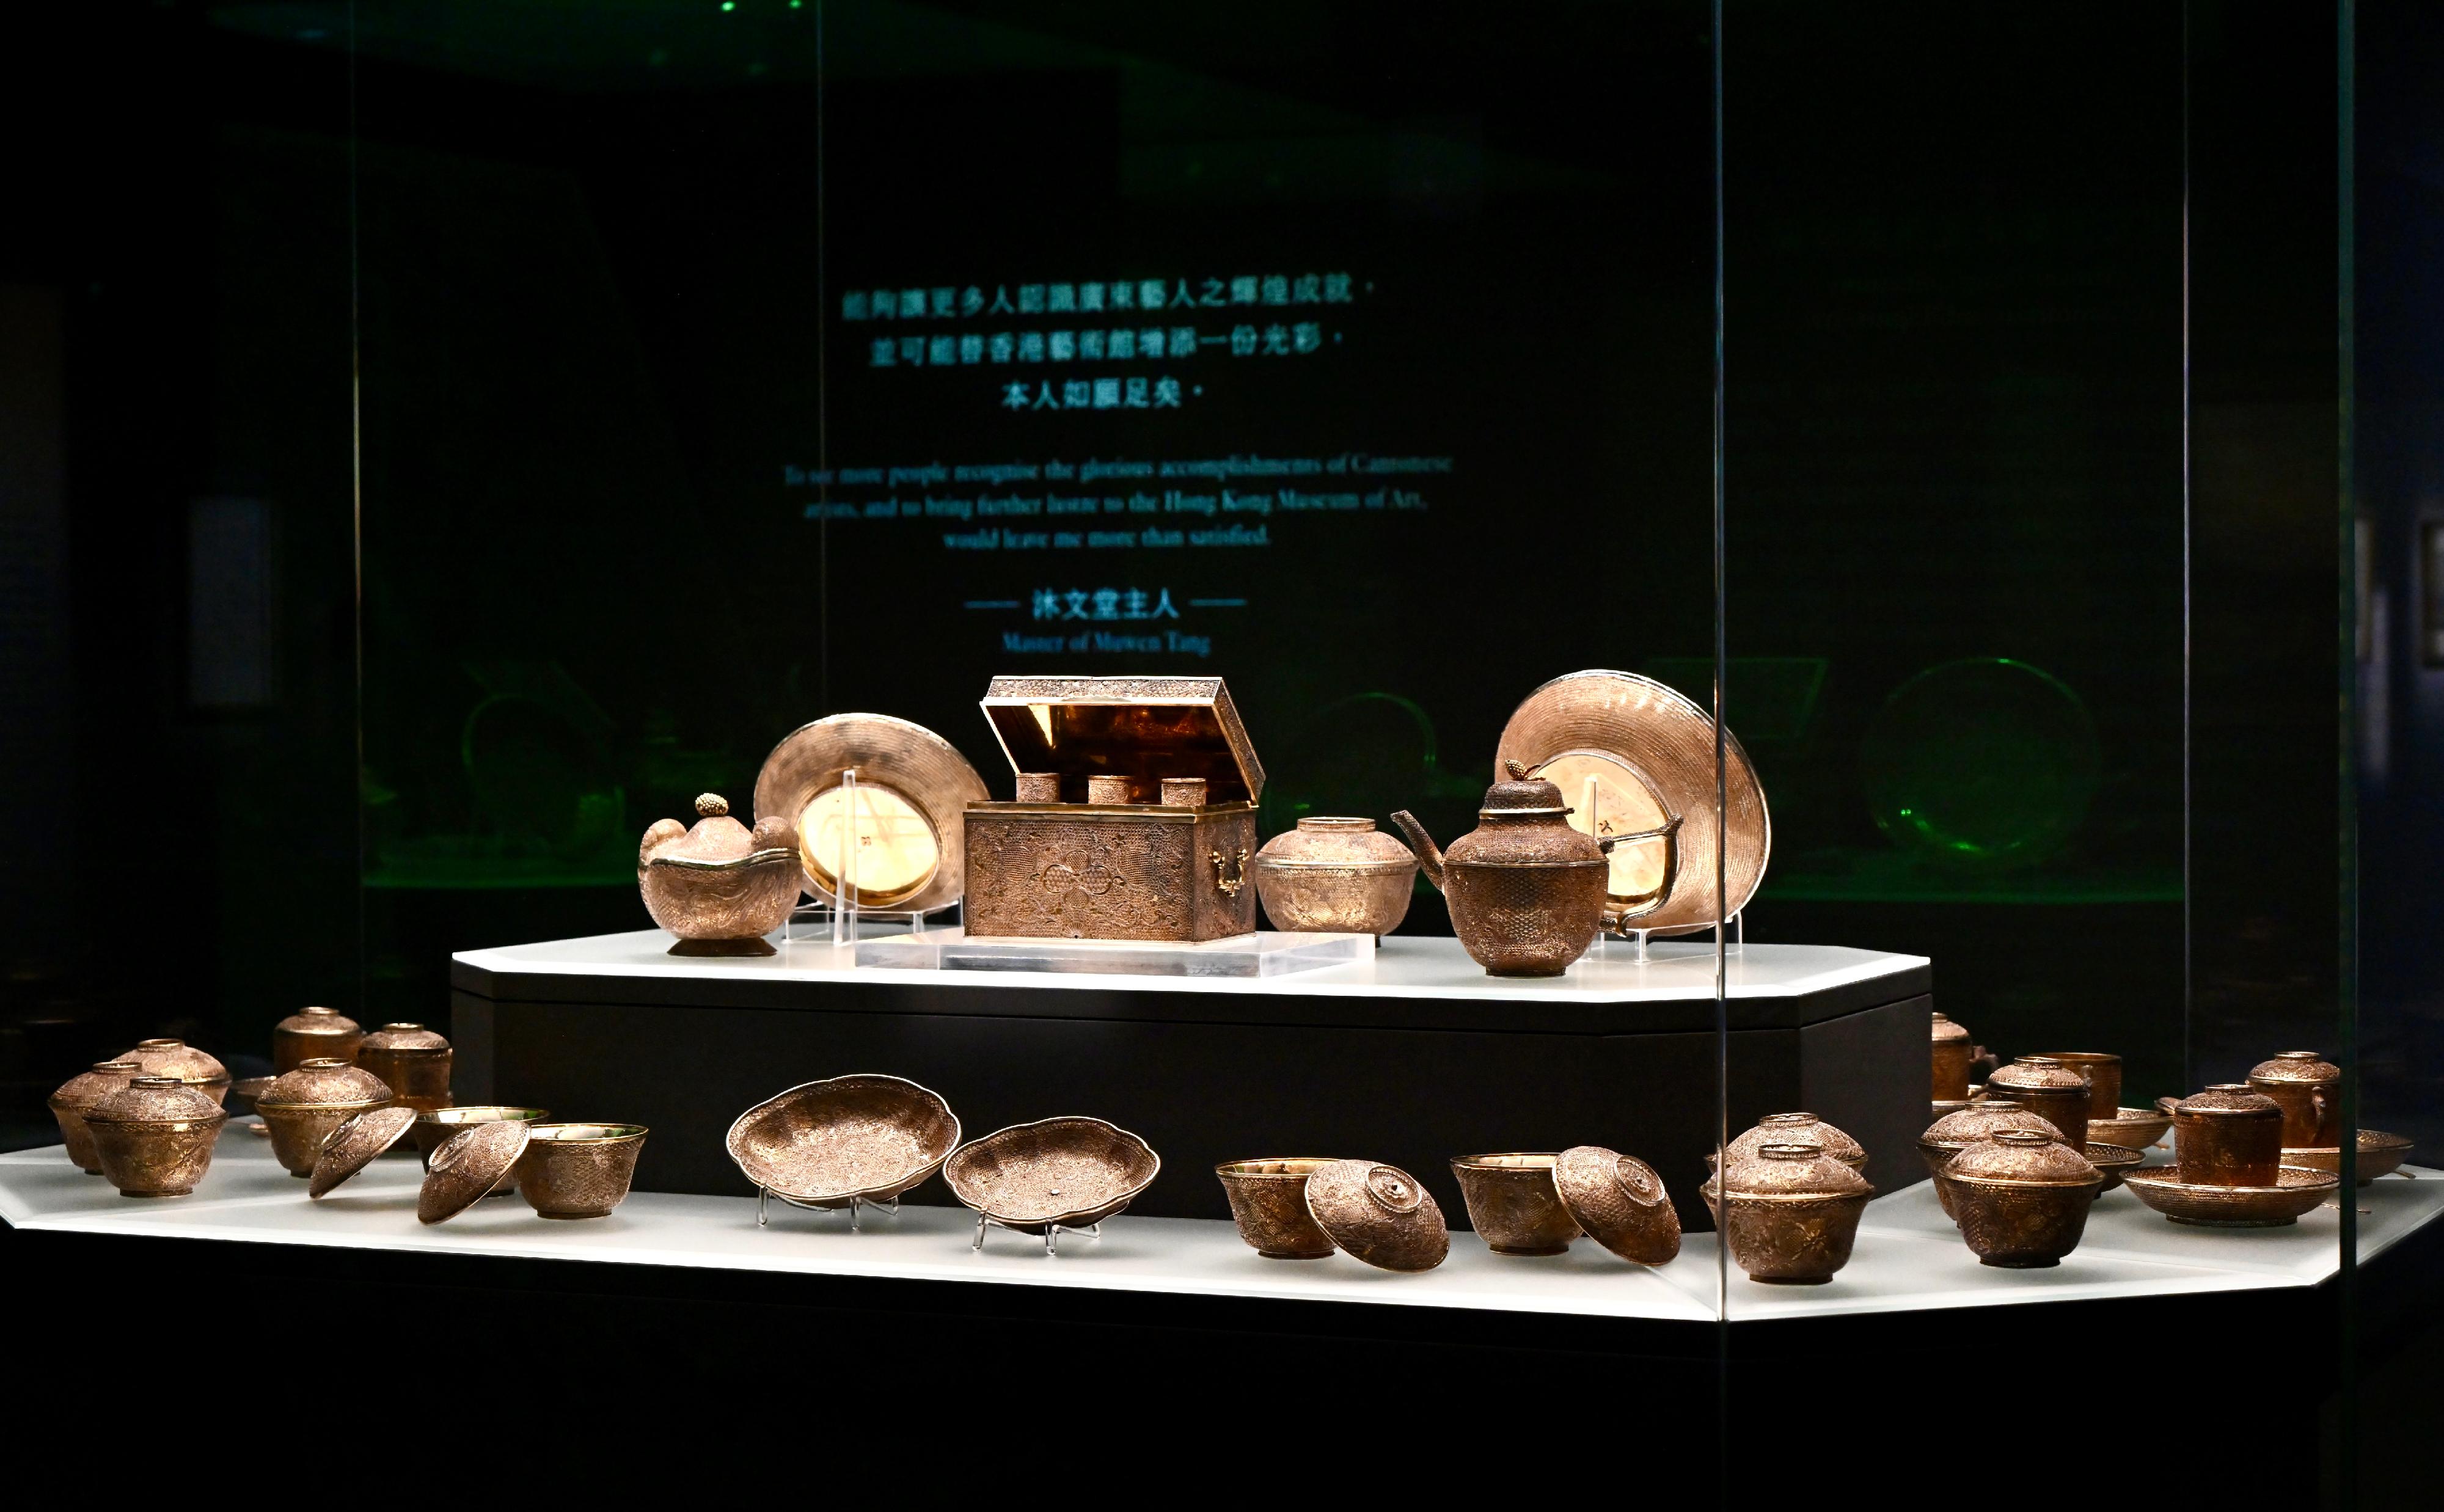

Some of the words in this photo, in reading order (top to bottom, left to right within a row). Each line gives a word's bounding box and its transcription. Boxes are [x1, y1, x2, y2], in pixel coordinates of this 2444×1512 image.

[1044, 459, 1075, 480] the
[1128, 491, 1158, 513] the
[1164, 490, 1217, 516] Hong
[1221, 489, 1272, 516] Kong
[1278, 489, 1359, 510] Museum
